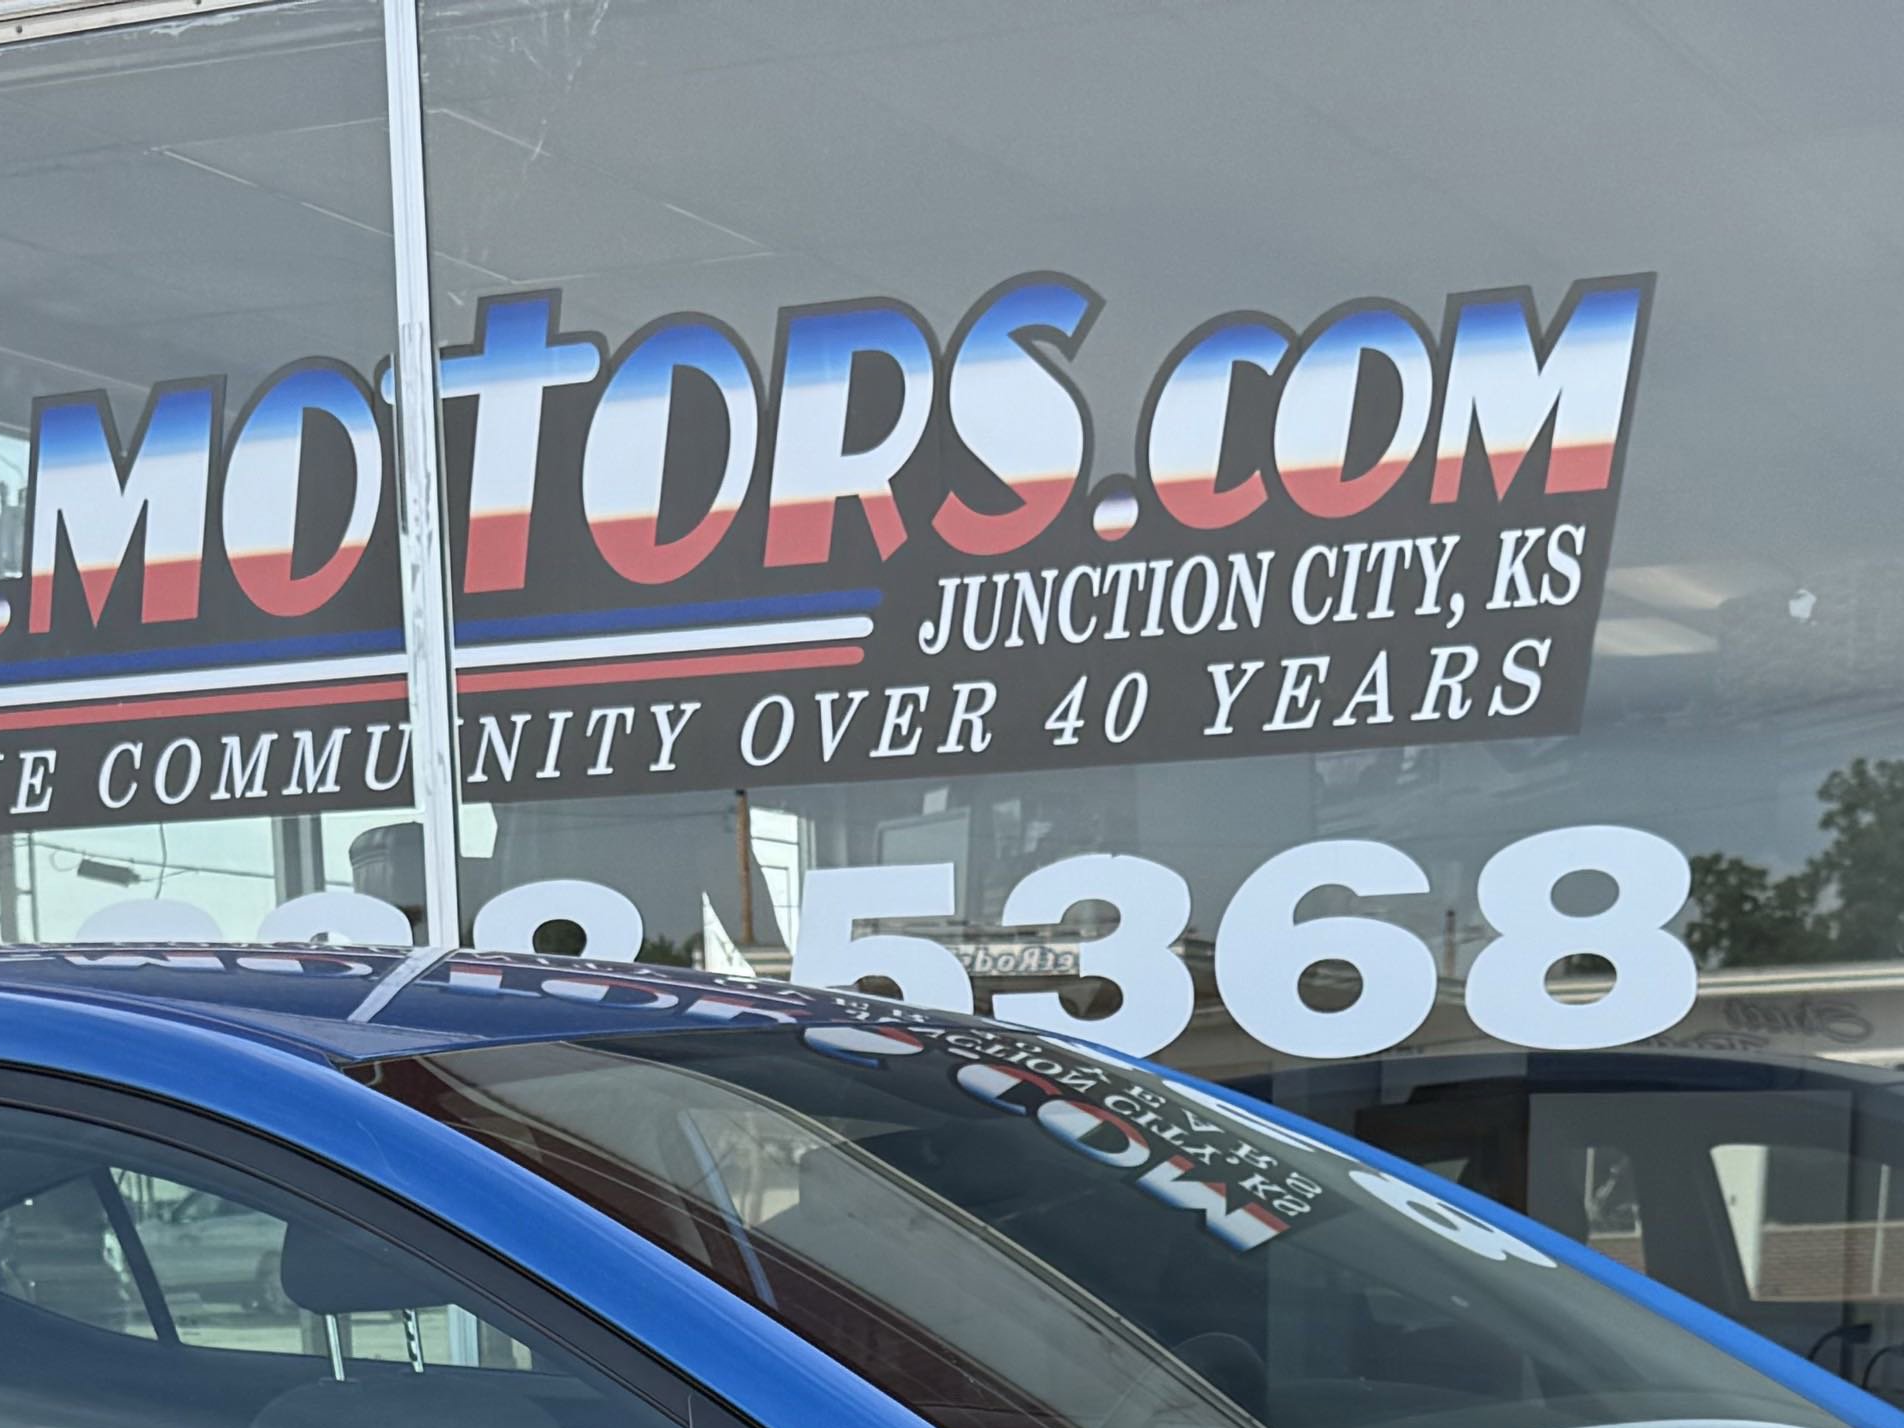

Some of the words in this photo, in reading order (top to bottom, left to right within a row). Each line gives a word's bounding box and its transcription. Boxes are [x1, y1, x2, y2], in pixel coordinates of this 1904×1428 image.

[917, 550, 1276, 656] JUNCTION
[1291, 534, 1461, 630] CITY,
[1485, 522, 1587, 611] KS
[97, 701, 701, 810] COMMUNITY
[739, 680, 998, 768] OVER
[1043, 671, 1149, 747] 40
[1202, 636, 1553, 736] YEARS
